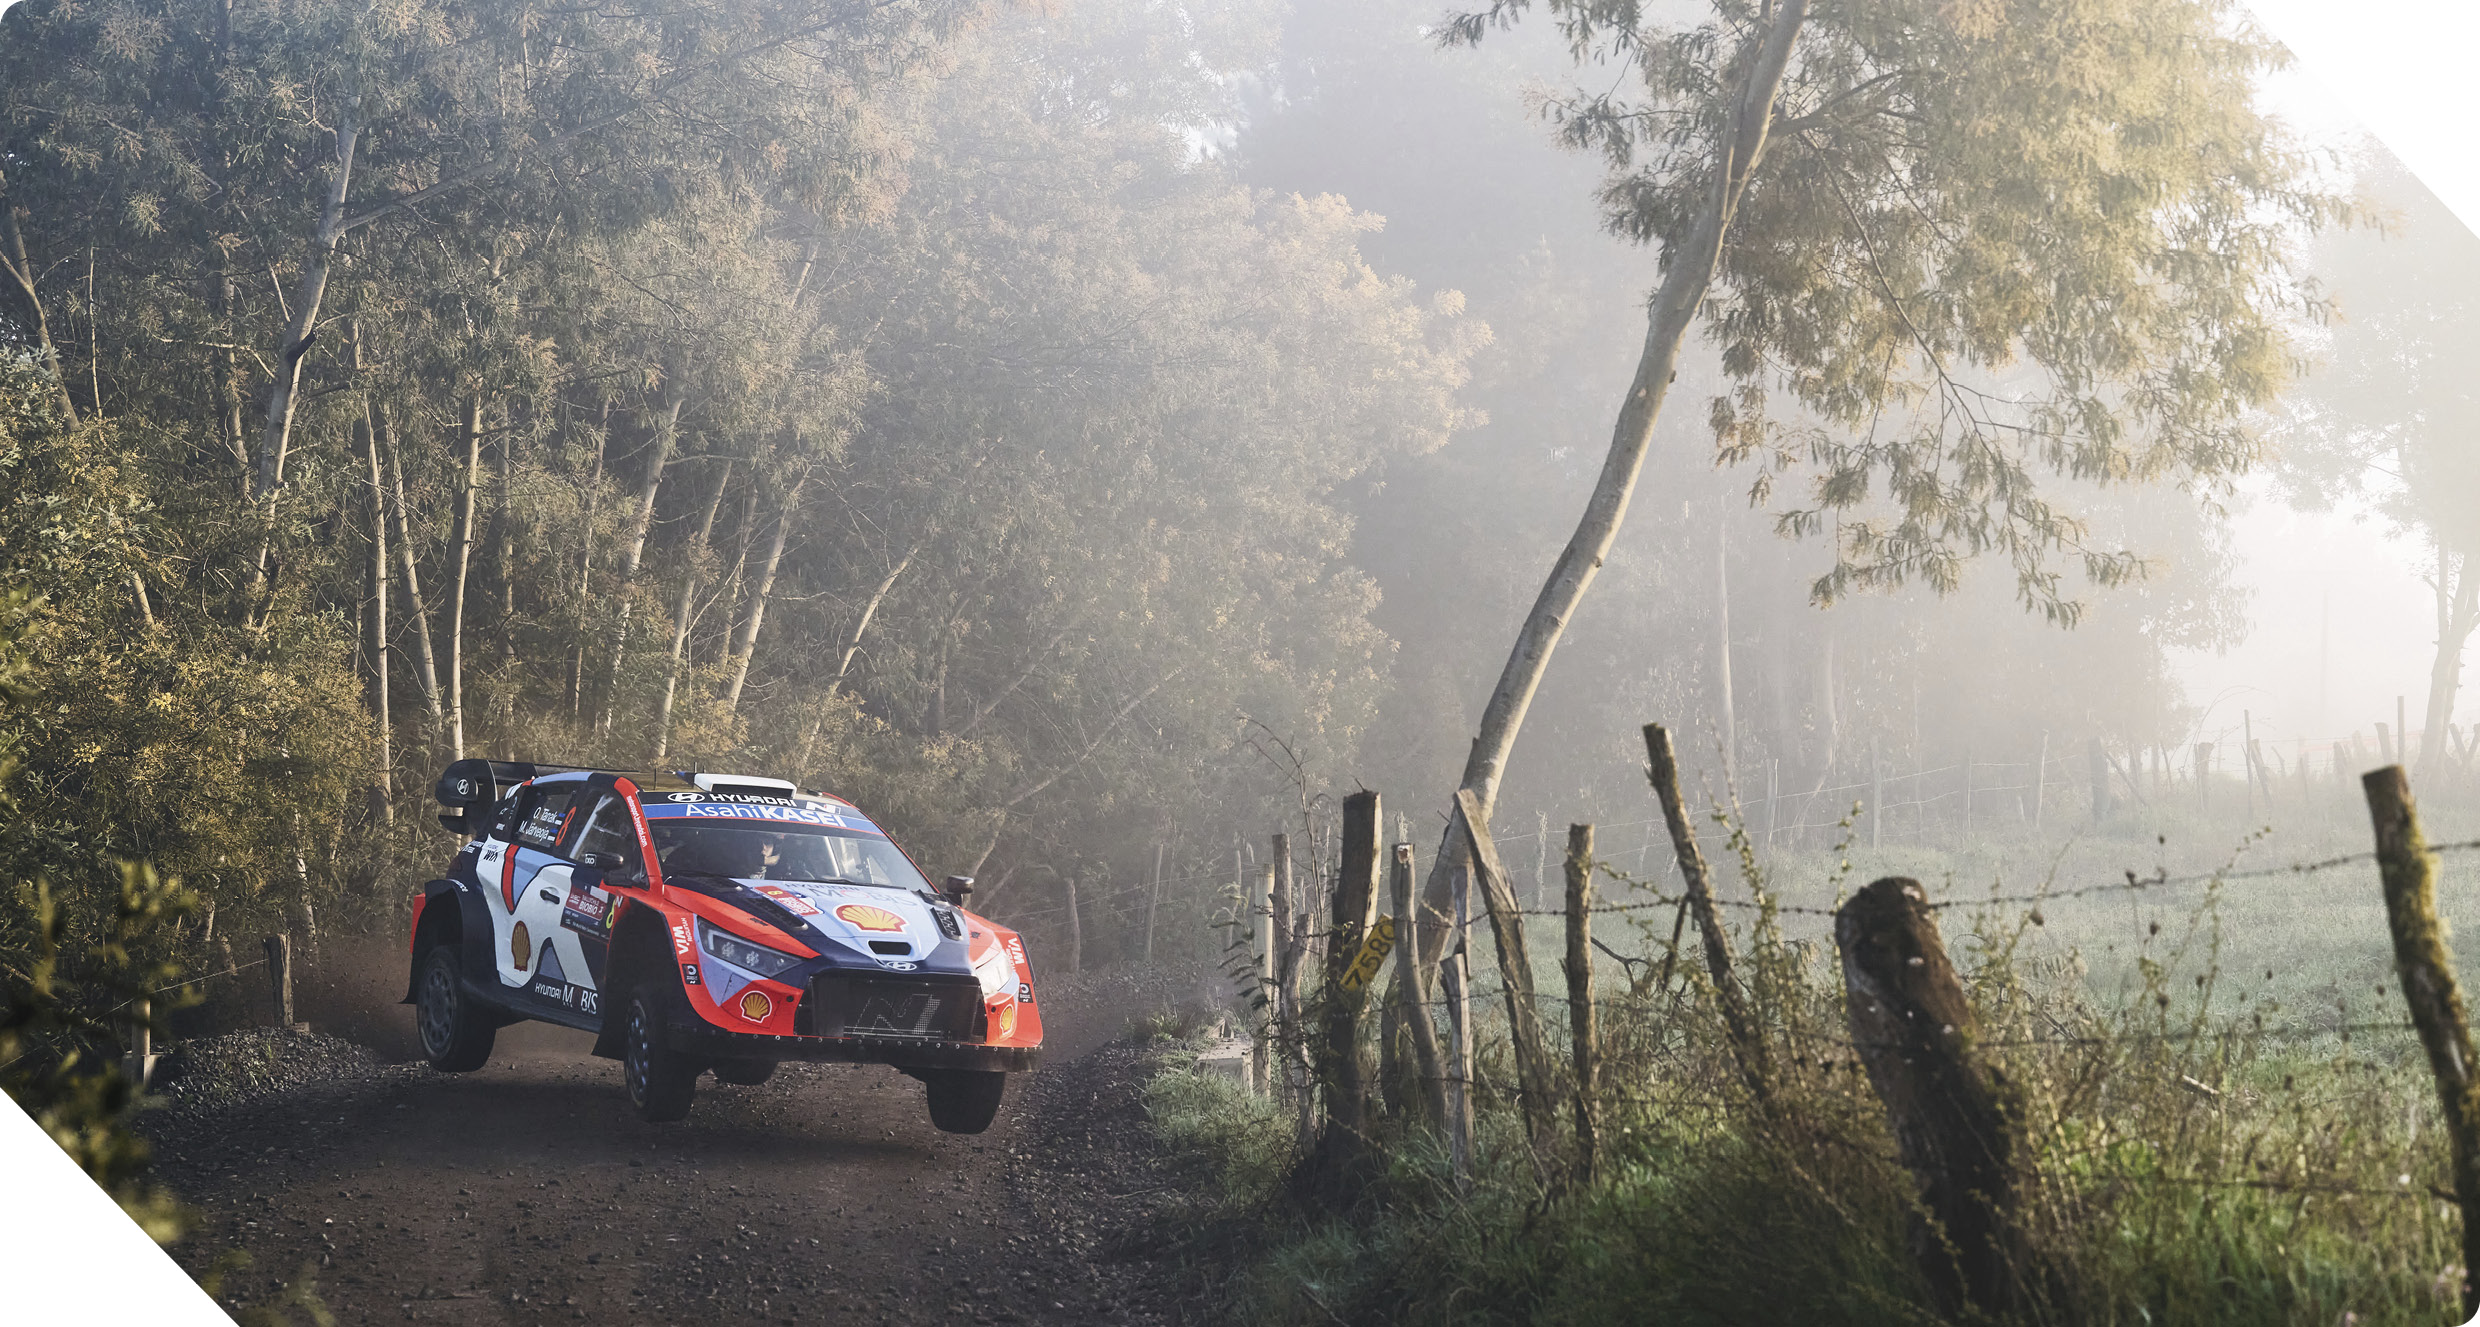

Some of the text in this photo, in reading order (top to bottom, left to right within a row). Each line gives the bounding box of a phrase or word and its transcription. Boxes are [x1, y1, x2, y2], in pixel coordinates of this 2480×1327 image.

[709, 793, 797, 807] HYUNDAI
[555, 806, 577, 847] 8
[535, 982, 561, 999] HYUNDAI
